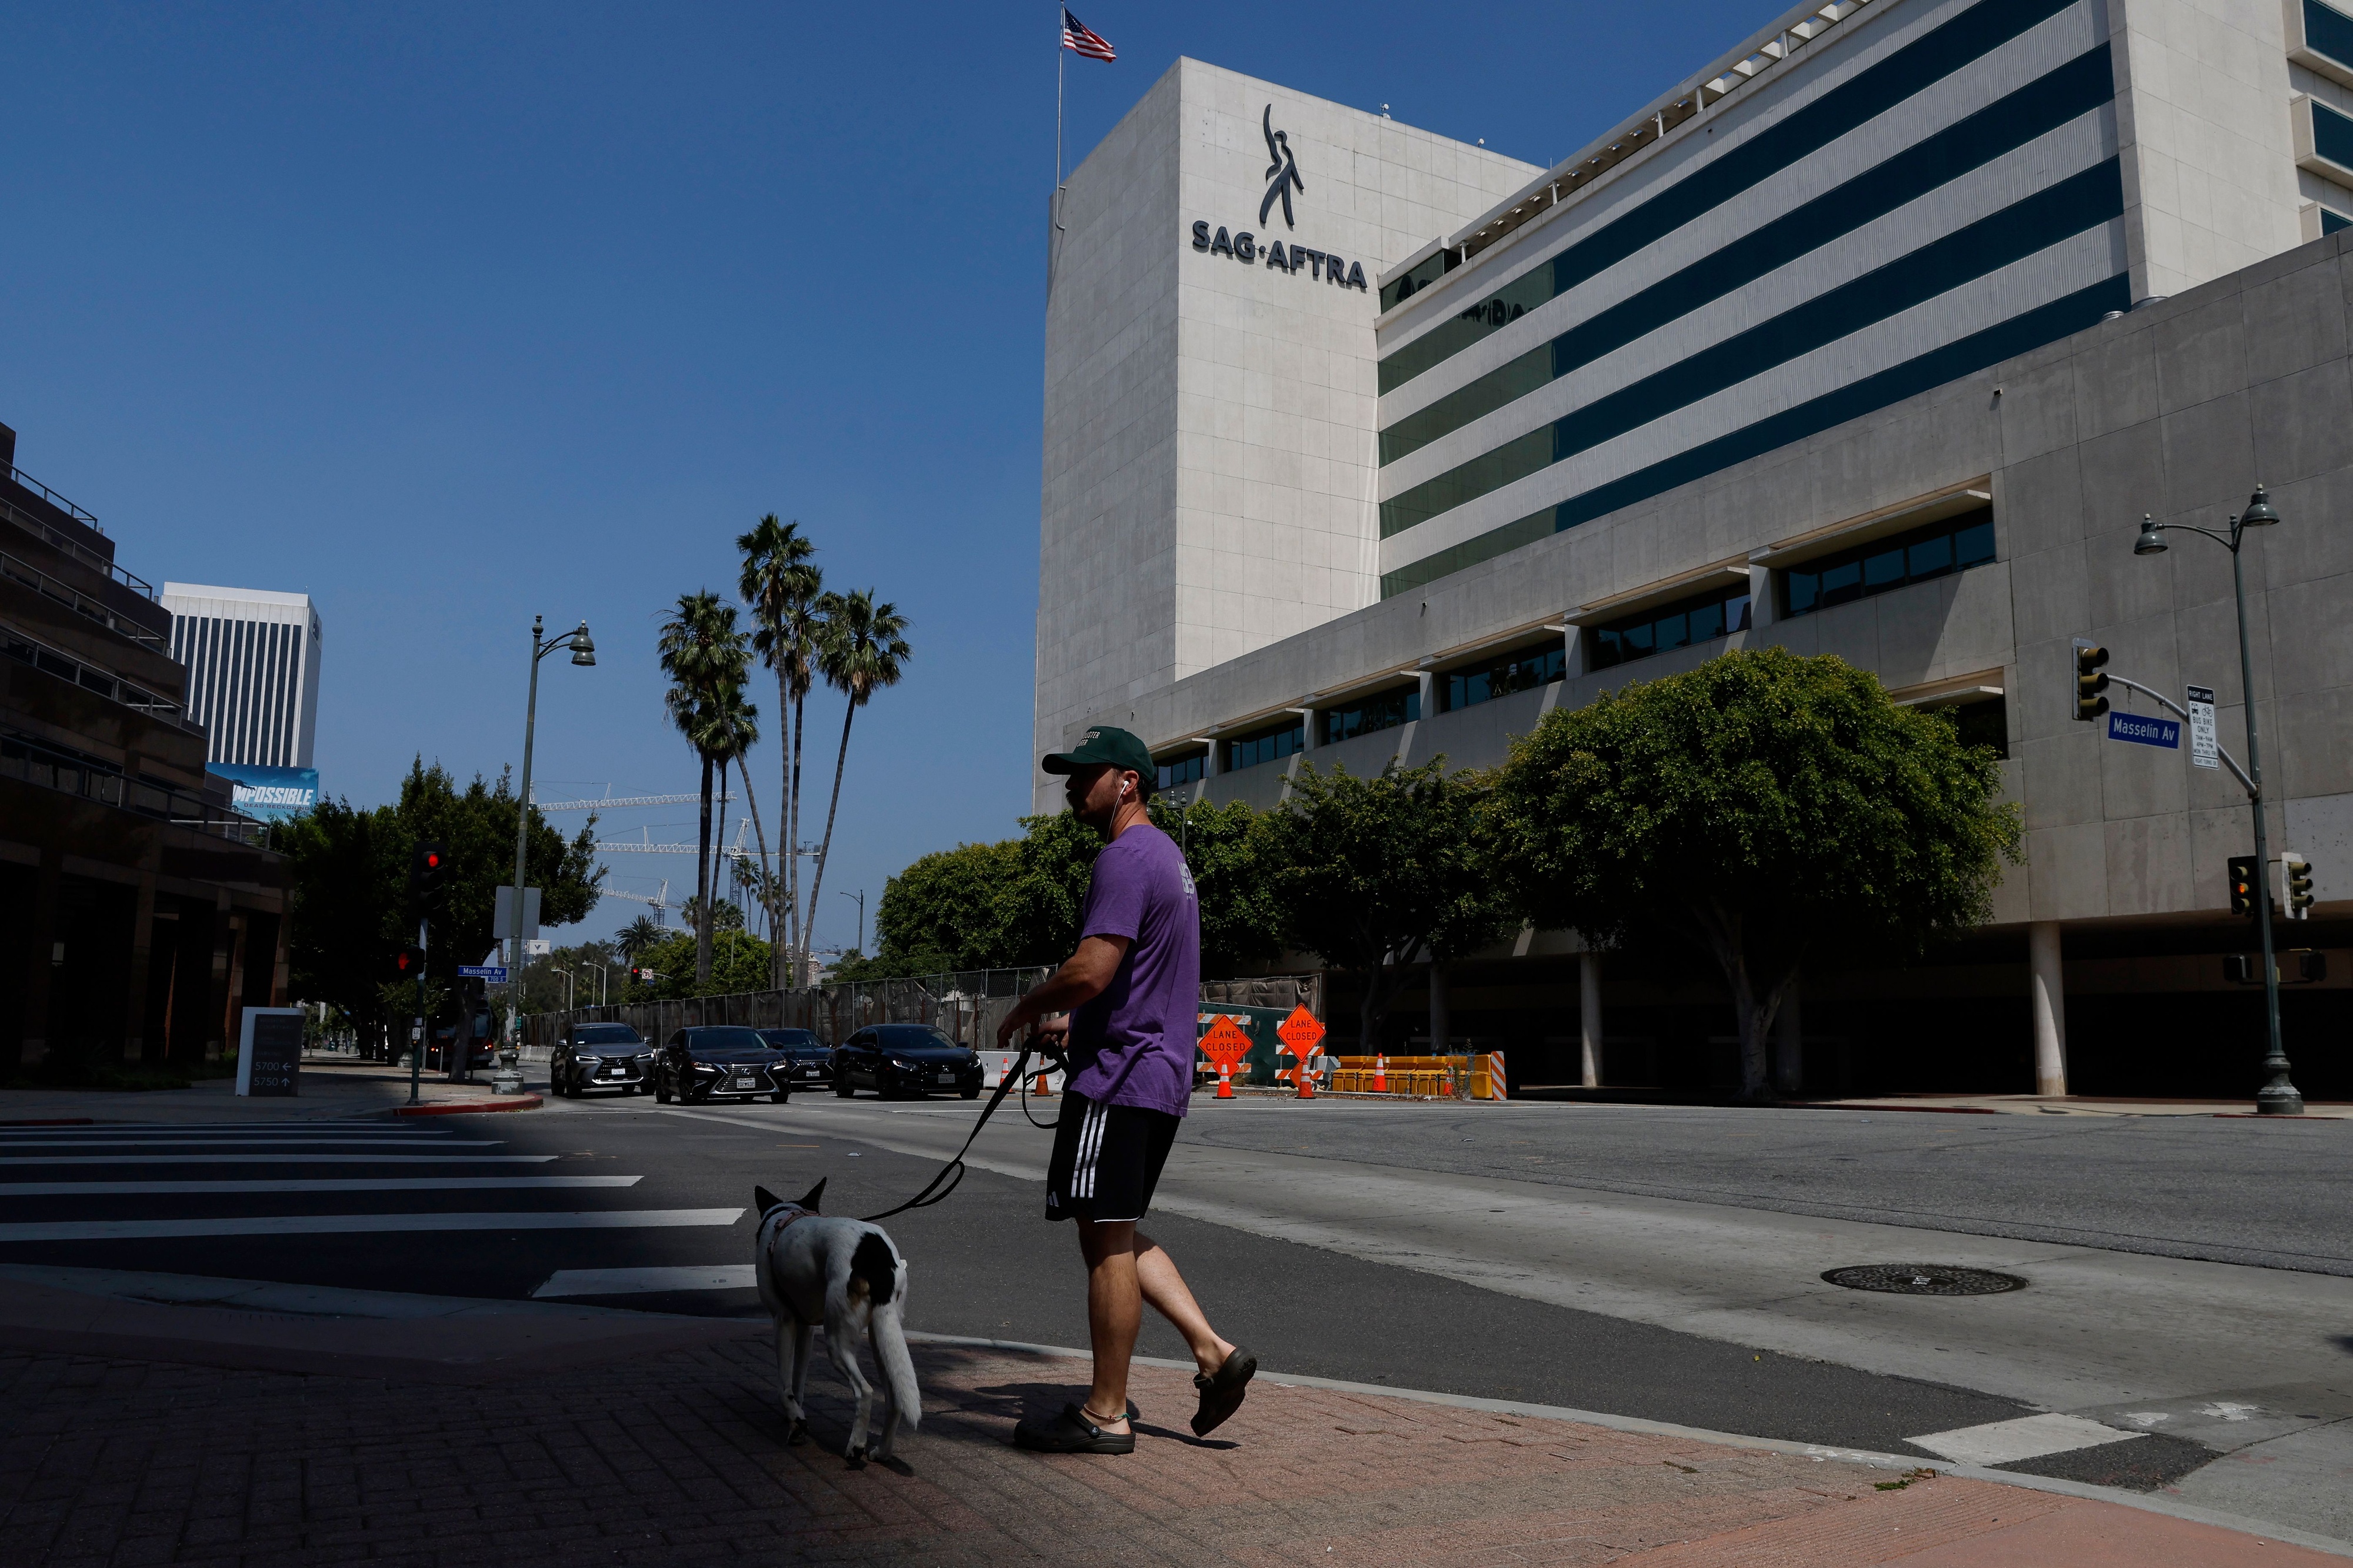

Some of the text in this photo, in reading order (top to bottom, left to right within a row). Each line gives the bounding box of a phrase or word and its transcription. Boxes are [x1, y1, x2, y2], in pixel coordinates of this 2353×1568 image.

[2189, 690, 2213, 700] RIGHT LANE
[2203, 718, 2213, 726] BIKE
[2114, 718, 2175, 741] Masselin Av
[2197, 725, 2209, 734] ONLY
[233, 785, 314, 805] IMPOSSIBLE
[1291, 1019, 1311, 1028] LANE
[1213, 1030, 1237, 1039] LANE
[1286, 1032, 1317, 1041] CLOSED
[1206, 1043, 1245, 1052] CLOSED
[255, 1062, 279, 1071] 5700
[254, 1077, 278, 1086] 5750
